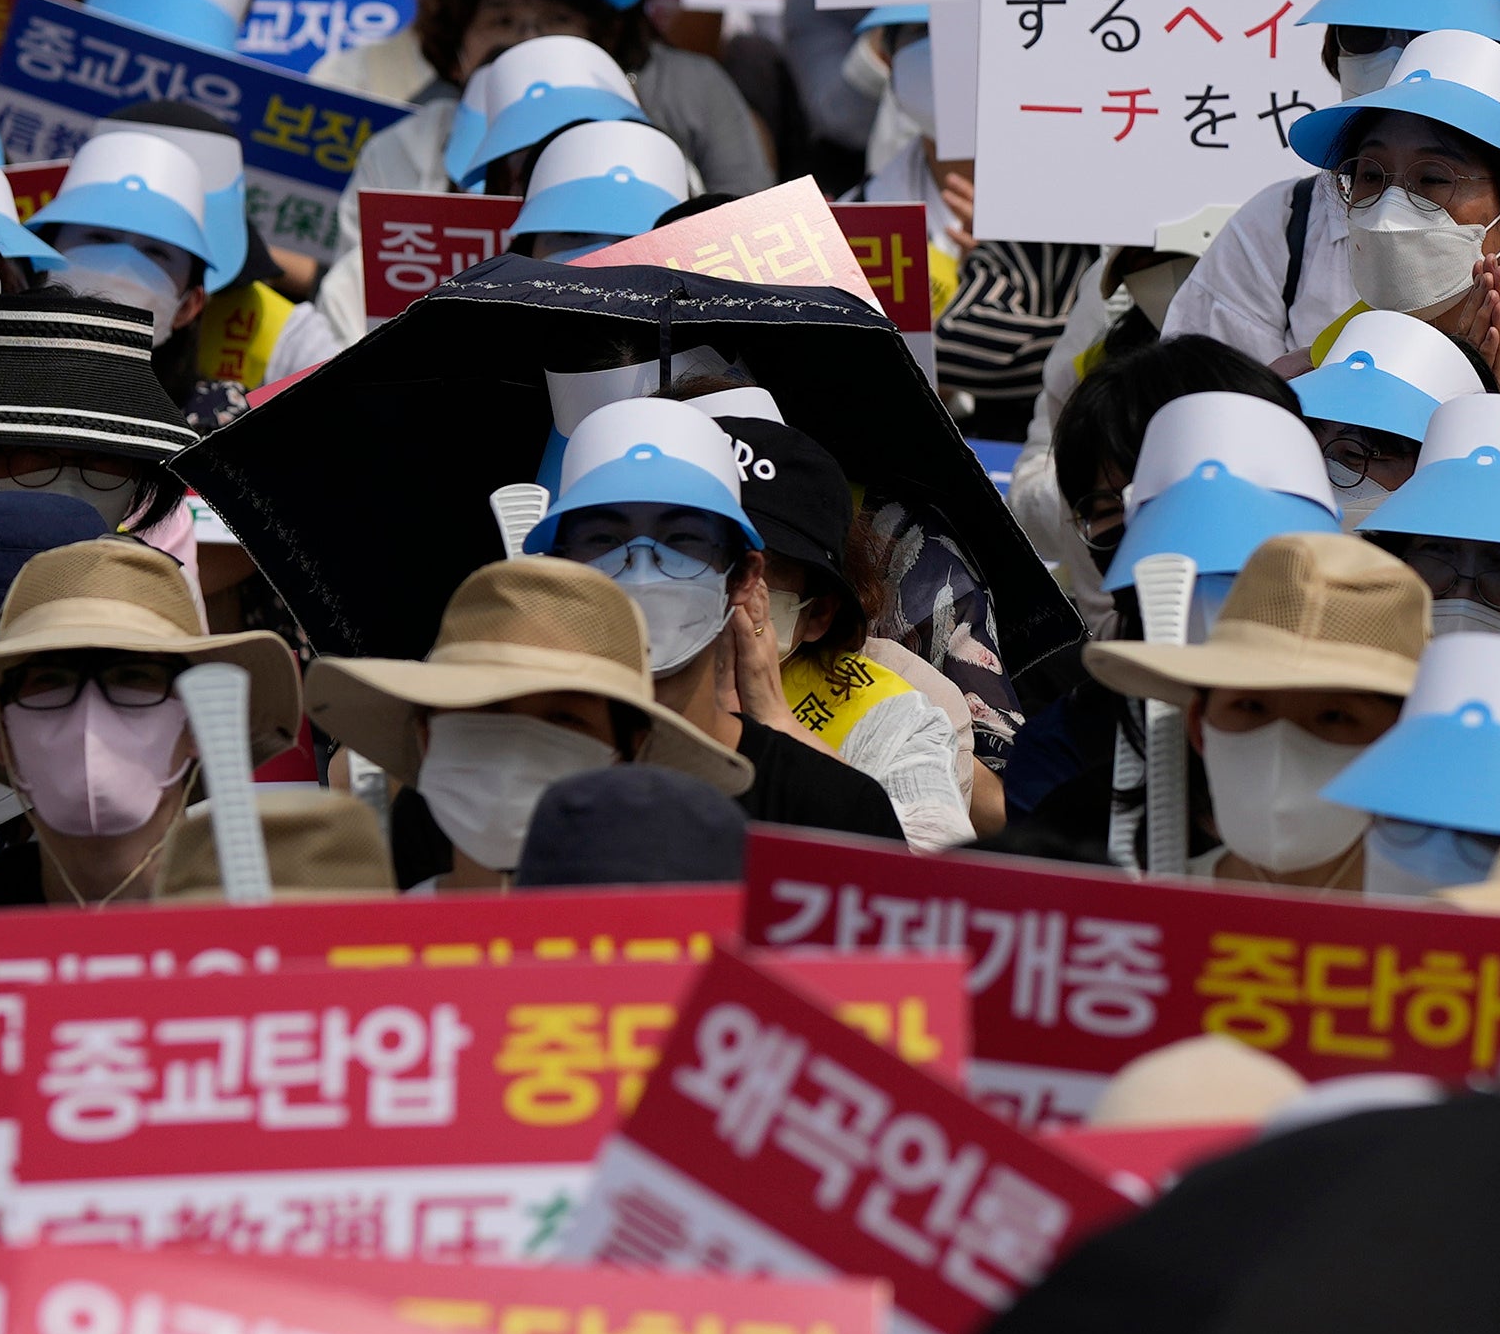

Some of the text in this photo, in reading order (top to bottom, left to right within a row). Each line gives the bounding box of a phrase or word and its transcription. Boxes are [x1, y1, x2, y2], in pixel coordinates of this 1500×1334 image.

[15, 15, 242, 124] 종교자유
[377, 219, 513, 297] 종교
[666, 212, 834, 288] 하라
[791, 656, 876, 733] 家庭
[37, 1002, 476, 1144] 종교탄압
[672, 1000, 1073, 1315] 왜곡언론
